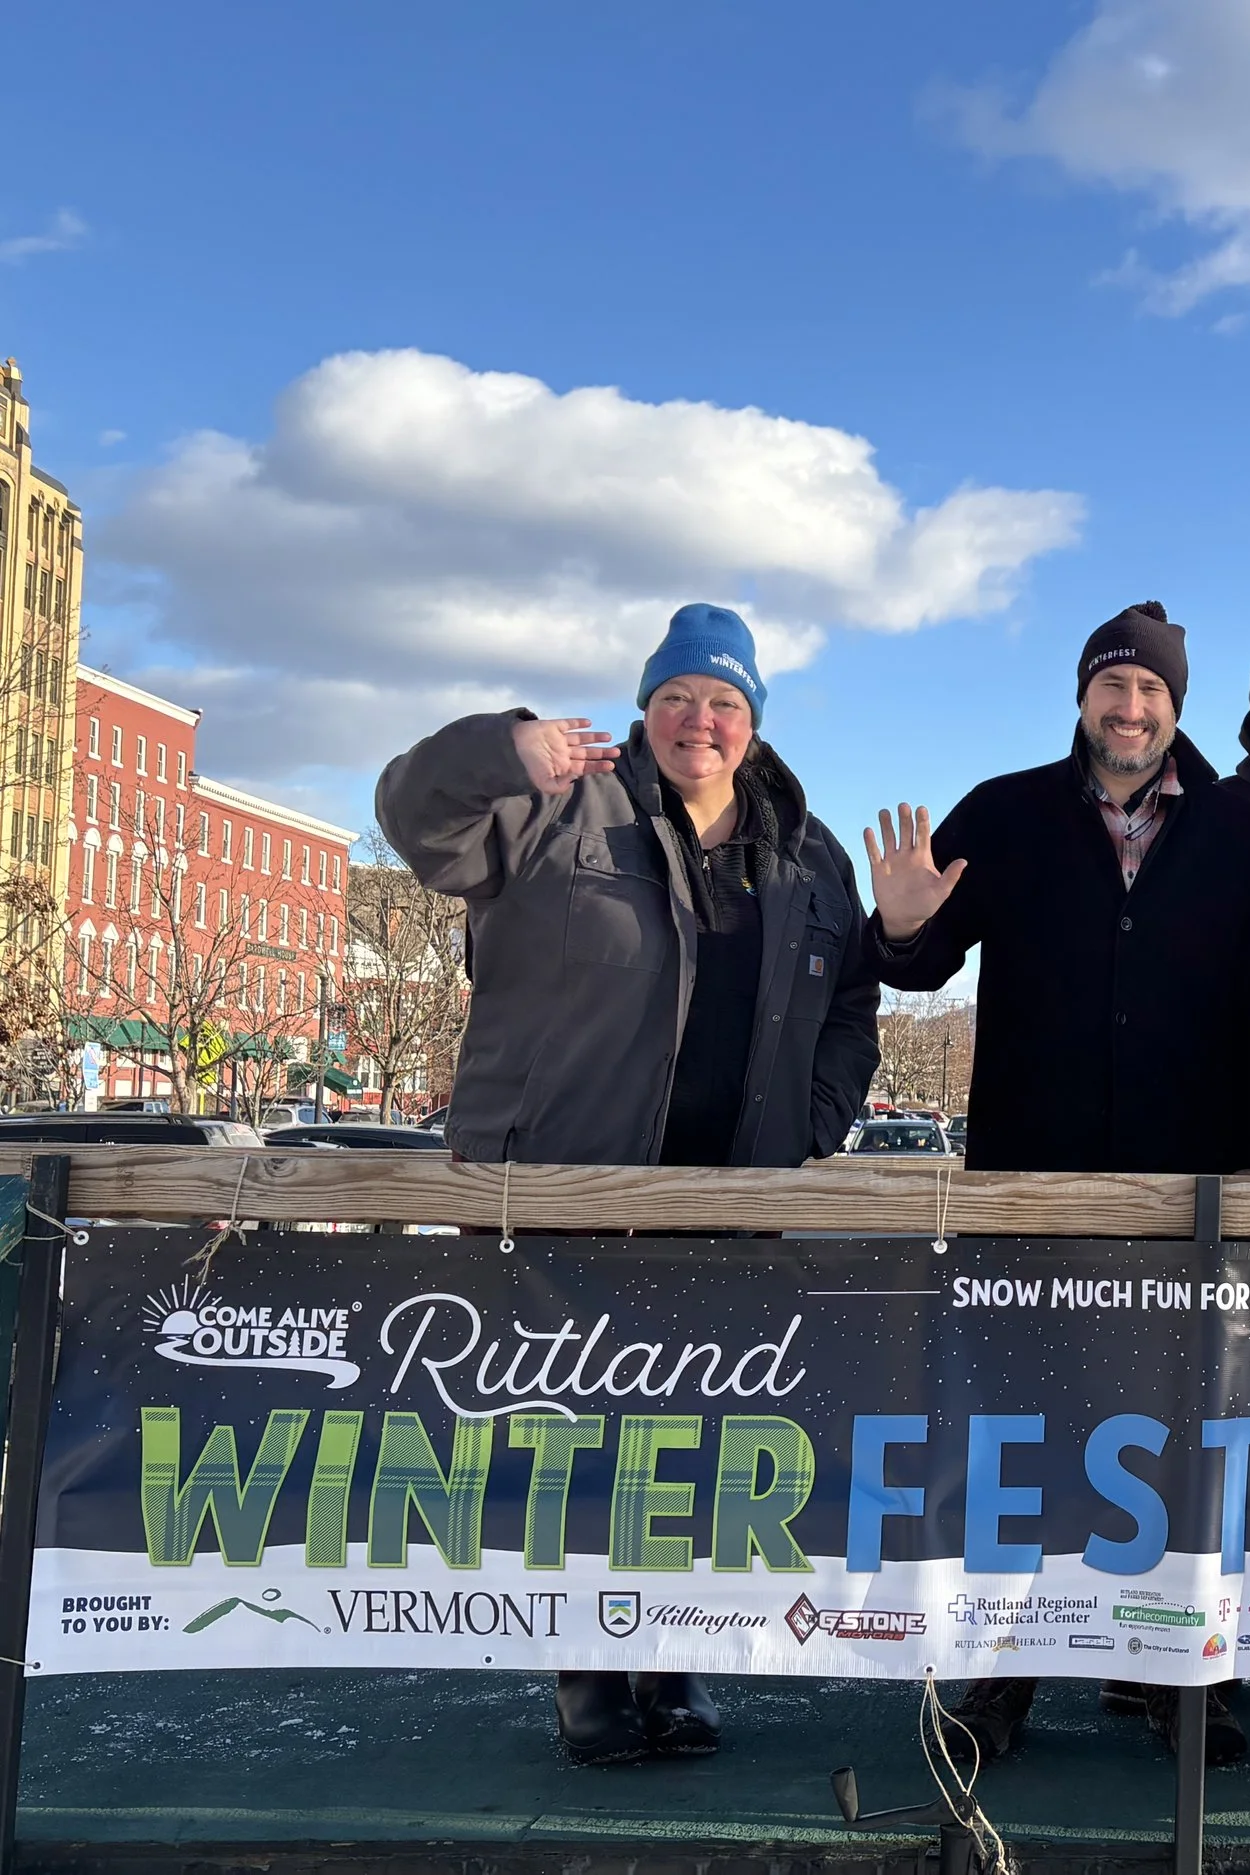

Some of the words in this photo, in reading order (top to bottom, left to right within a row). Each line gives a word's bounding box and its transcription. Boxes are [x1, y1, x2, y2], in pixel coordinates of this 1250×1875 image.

[952, 1277, 1042, 1308] SNOW
[1050, 1278, 1132, 1310] MUCH
[1141, 1279, 1191, 1310] FUN
[1200, 1282, 1250, 1311] FOR
[200, 1306, 272, 1327] COME
[277, 1307, 349, 1328] ALIVE
[193, 1327, 347, 1357] OUTSIDE
[380, 1293, 806, 1422] Rutland
[62, 1595, 151, 1613] BROUGHT
[977, 1597, 1032, 1610] Rutland
[1037, 1596, 1098, 1612] Regional
[328, 1590, 568, 1638] VERMONT
[646, 1603, 770, 1636] Killington
[984, 1611, 1039, 1625] Medical
[1043, 1610, 1091, 1623] Center
[1120, 1608, 1200, 1626] forthecommunity
[61, 1618, 86, 1634] TO
[93, 1616, 131, 1633] YOU
[138, 1615, 170, 1631] BY:
[836, 1630, 905, 1641] MOTORS
[955, 1640, 997, 1649] RUTLAND
[1016, 1638, 1057, 1646] HERALD
